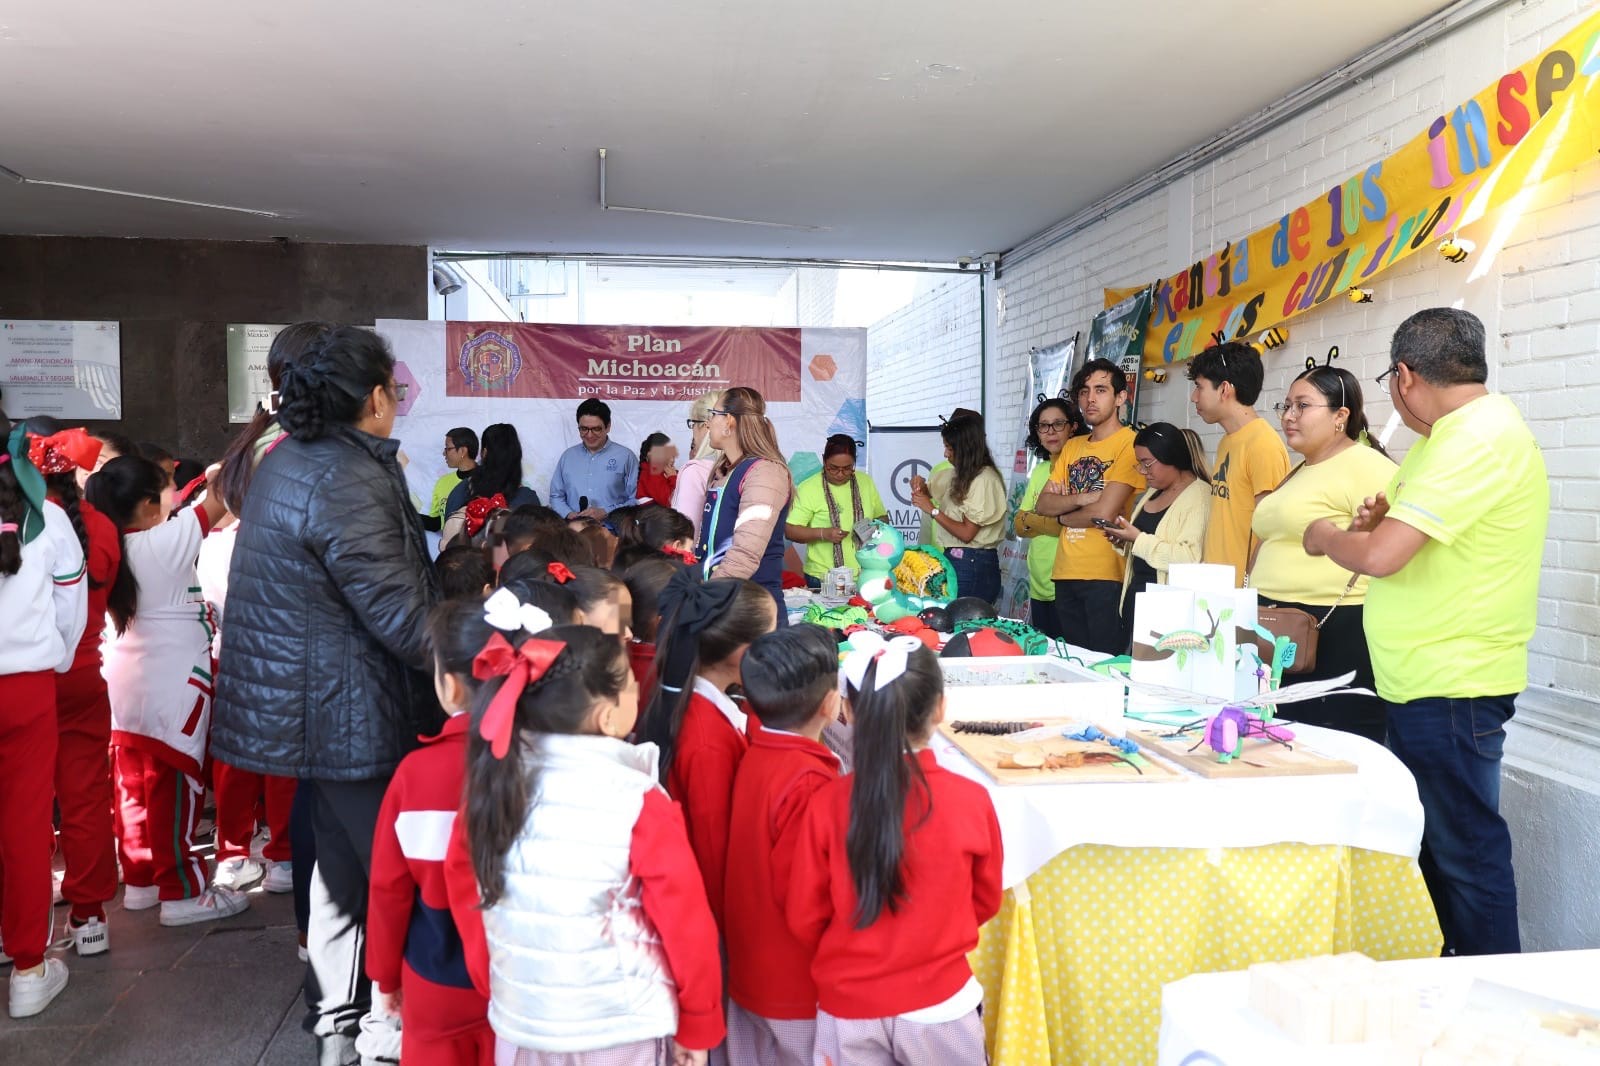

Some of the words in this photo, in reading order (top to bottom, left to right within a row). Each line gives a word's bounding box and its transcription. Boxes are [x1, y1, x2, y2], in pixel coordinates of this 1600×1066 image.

[1271, 212, 1311, 269] de
[1326, 160, 1387, 248] los
[1162, 316, 1204, 364] en
[1203, 292, 1264, 349] los
[627, 334, 681, 353] Plan
[587, 358, 720, 377] Michoacán
[578, 385, 602, 396] por
[607, 384, 618, 395] la
[623, 385, 645, 396] Paz
[650, 386, 658, 397] y
[663, 385, 675, 396] la
[82, 933, 105, 945] PUMA
